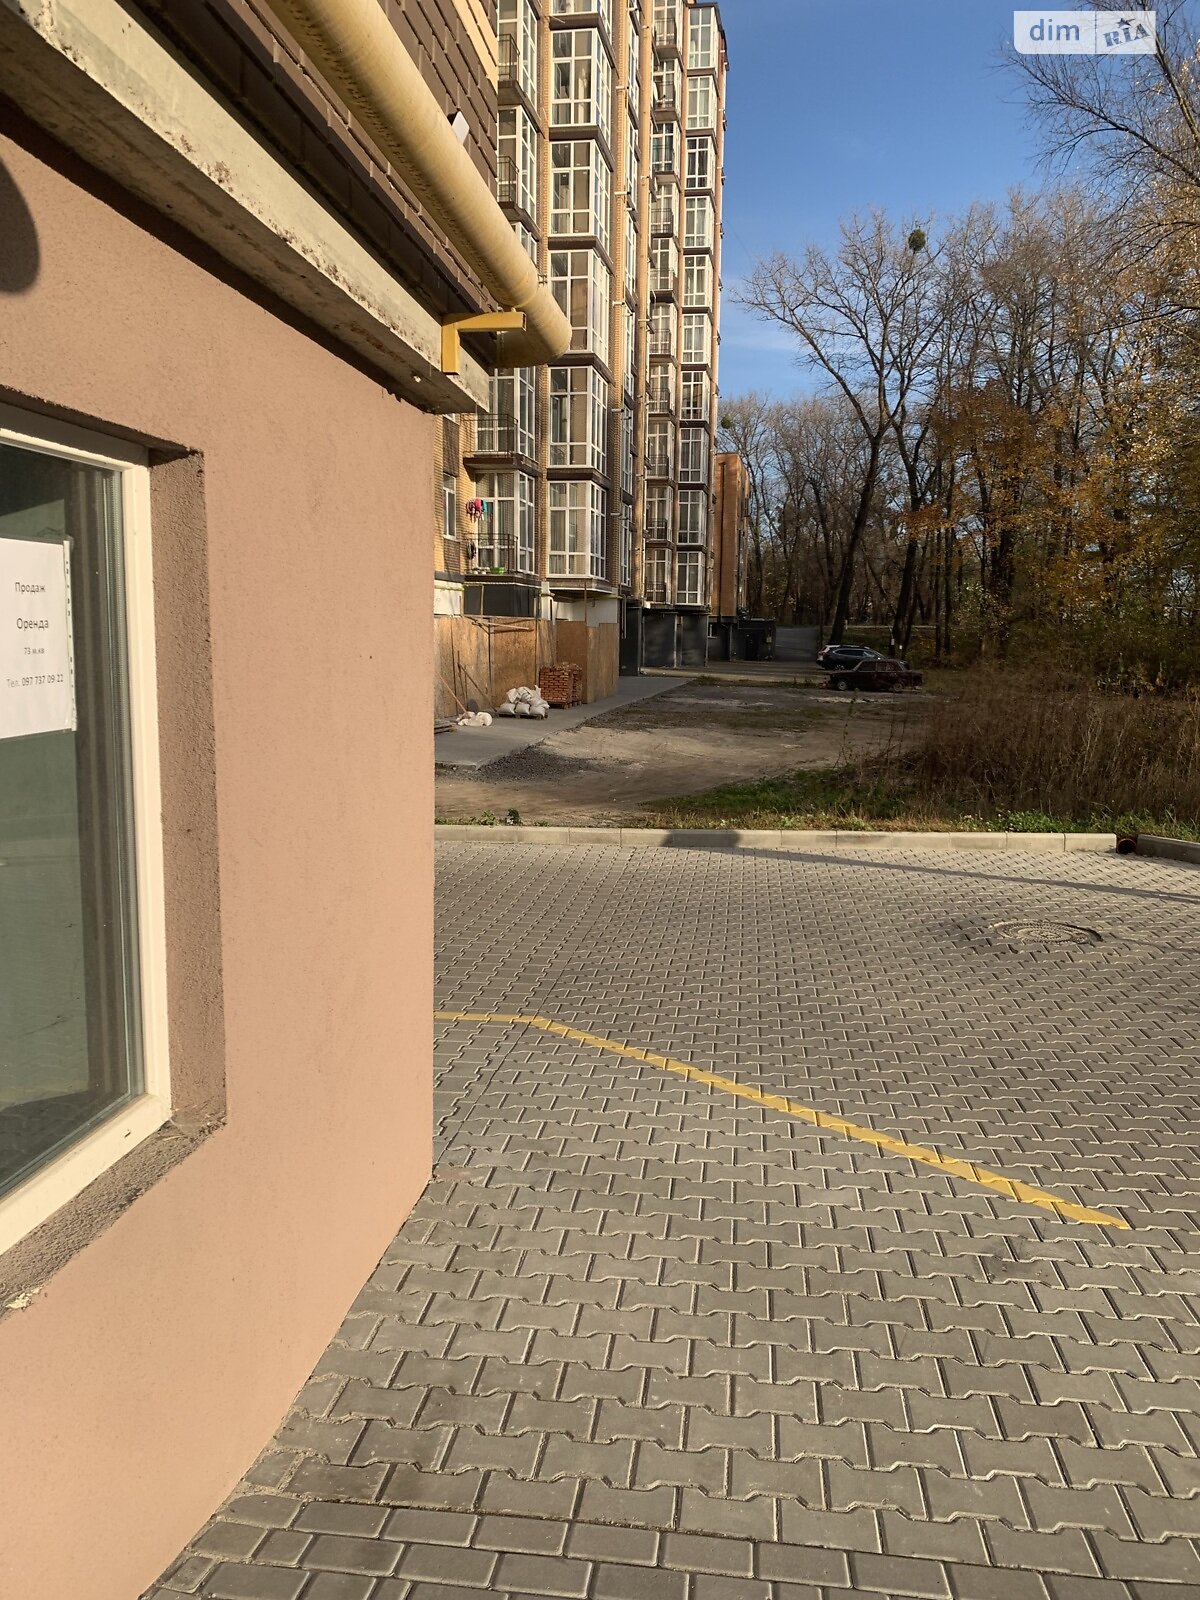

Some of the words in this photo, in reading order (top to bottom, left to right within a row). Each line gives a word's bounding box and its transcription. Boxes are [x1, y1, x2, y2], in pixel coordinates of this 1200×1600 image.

[15, 581, 46, 594] Продаж
[16, 617, 49, 631] Оренда
[24, 647, 31, 655] 73
[6, 678, 21, 688] Тел.
[22, 676, 33, 687] 097
[34, 675, 46, 685] 737
[47, 674, 56, 684] 09
[57, 673, 64, 683] 22
